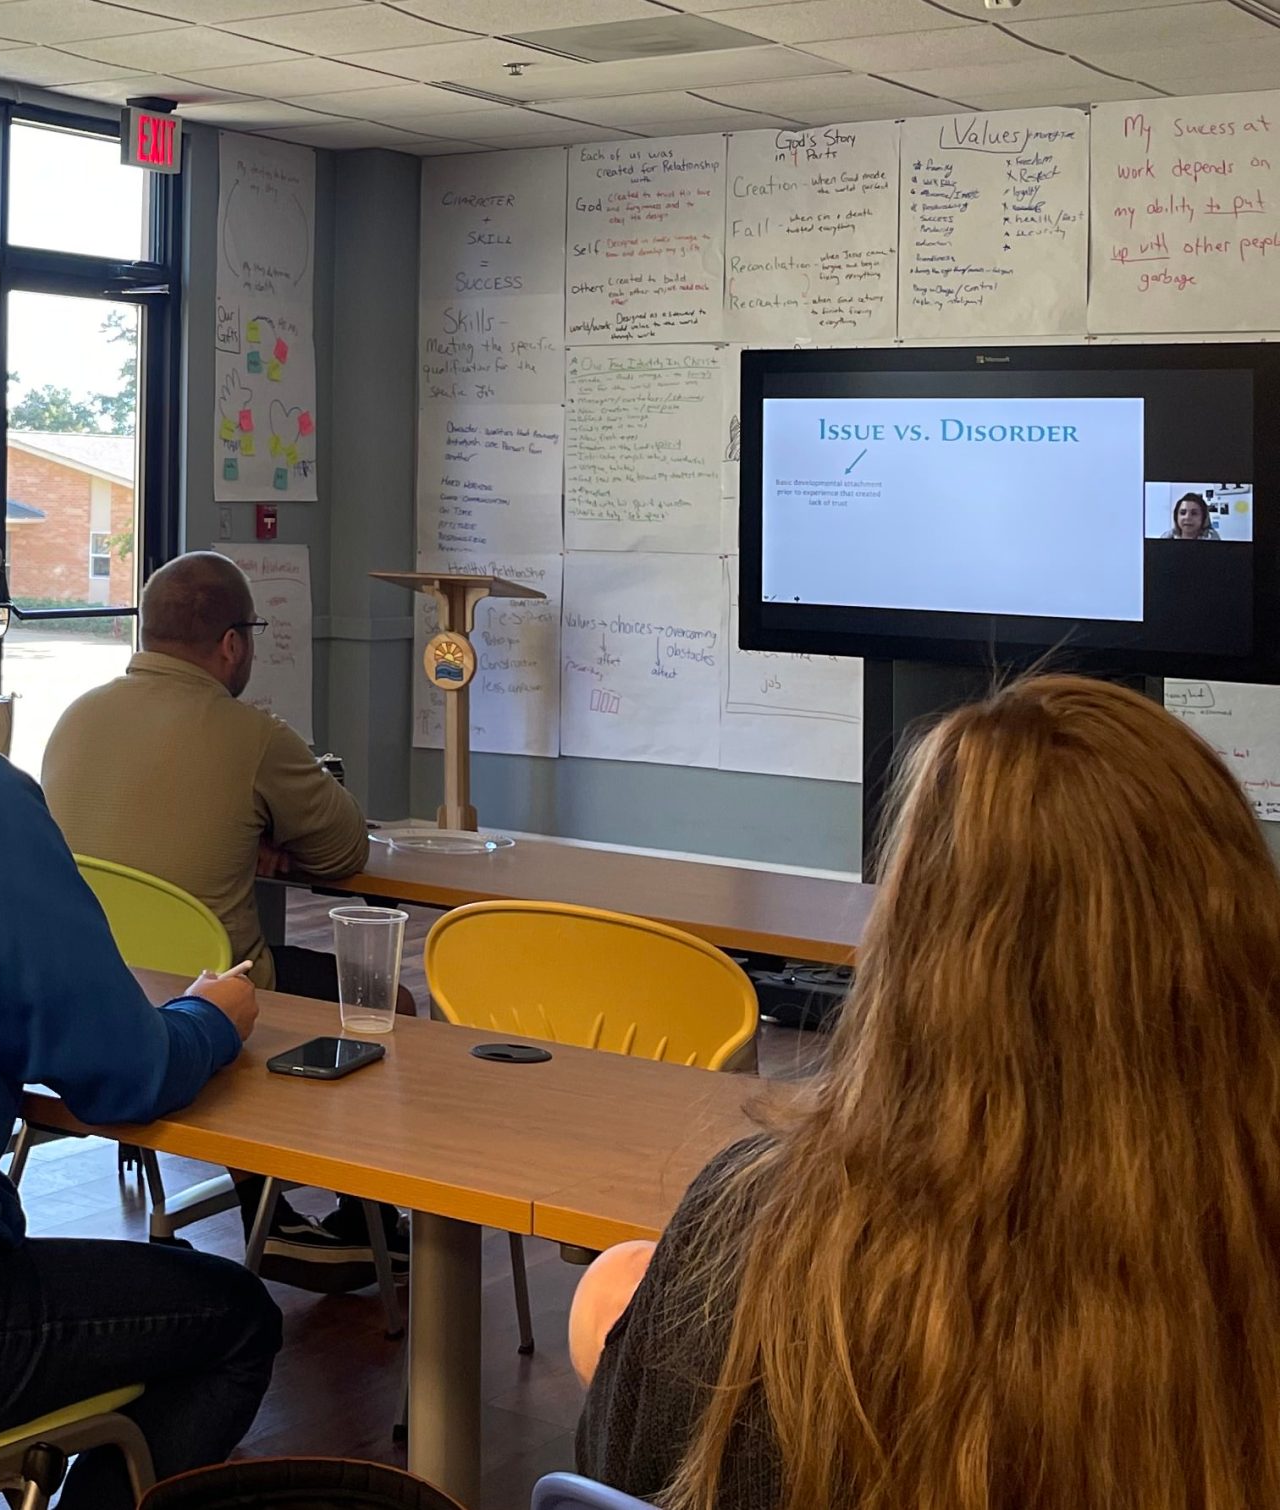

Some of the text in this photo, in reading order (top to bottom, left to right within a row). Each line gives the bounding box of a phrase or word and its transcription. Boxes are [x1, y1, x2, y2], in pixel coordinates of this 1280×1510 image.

[136, 113, 177, 167] EXIT
[775, 128, 858, 151] God's Story
[953, 116, 1021, 148] Values
[1124, 113, 1152, 154] My
[1243, 114, 1272, 133] at
[580, 148, 674, 162] Each of us was
[774, 147, 839, 168] in 4 Parts
[640, 162, 659, 174] for
[661, 159, 721, 174] Relationship
[1117, 155, 1271, 184] work depends on
[733, 174, 799, 198] Creation
[840, 171, 859, 183] God
[574, 196, 603, 212] God
[1113, 188, 1266, 230] my ability to put
[466, 231, 512, 246] SKILL
[732, 217, 770, 239] Fall
[573, 239, 601, 257] Self
[1112, 244, 1129, 266] up
[1183, 235, 1232, 256] other
[1239, 232, 1280, 263] peopl
[730, 255, 811, 274] Reconciliation
[455, 271, 523, 291] SUCCESS
[1137, 266, 1198, 293] garbage
[729, 293, 800, 311] Recreation
[218, 304, 236, 323] Our
[480, 336, 503, 353] the
[776, 488, 882, 499] prior to experience that created
[793, 479, 843, 488] developmental
[843, 480, 883, 489] attachment
[808, 499, 848, 508] lack of trust
[609, 614, 654, 635] choices
[665, 625, 718, 649] Overcoming
[666, 643, 716, 667] Obstacles
[760, 672, 782, 694] job
